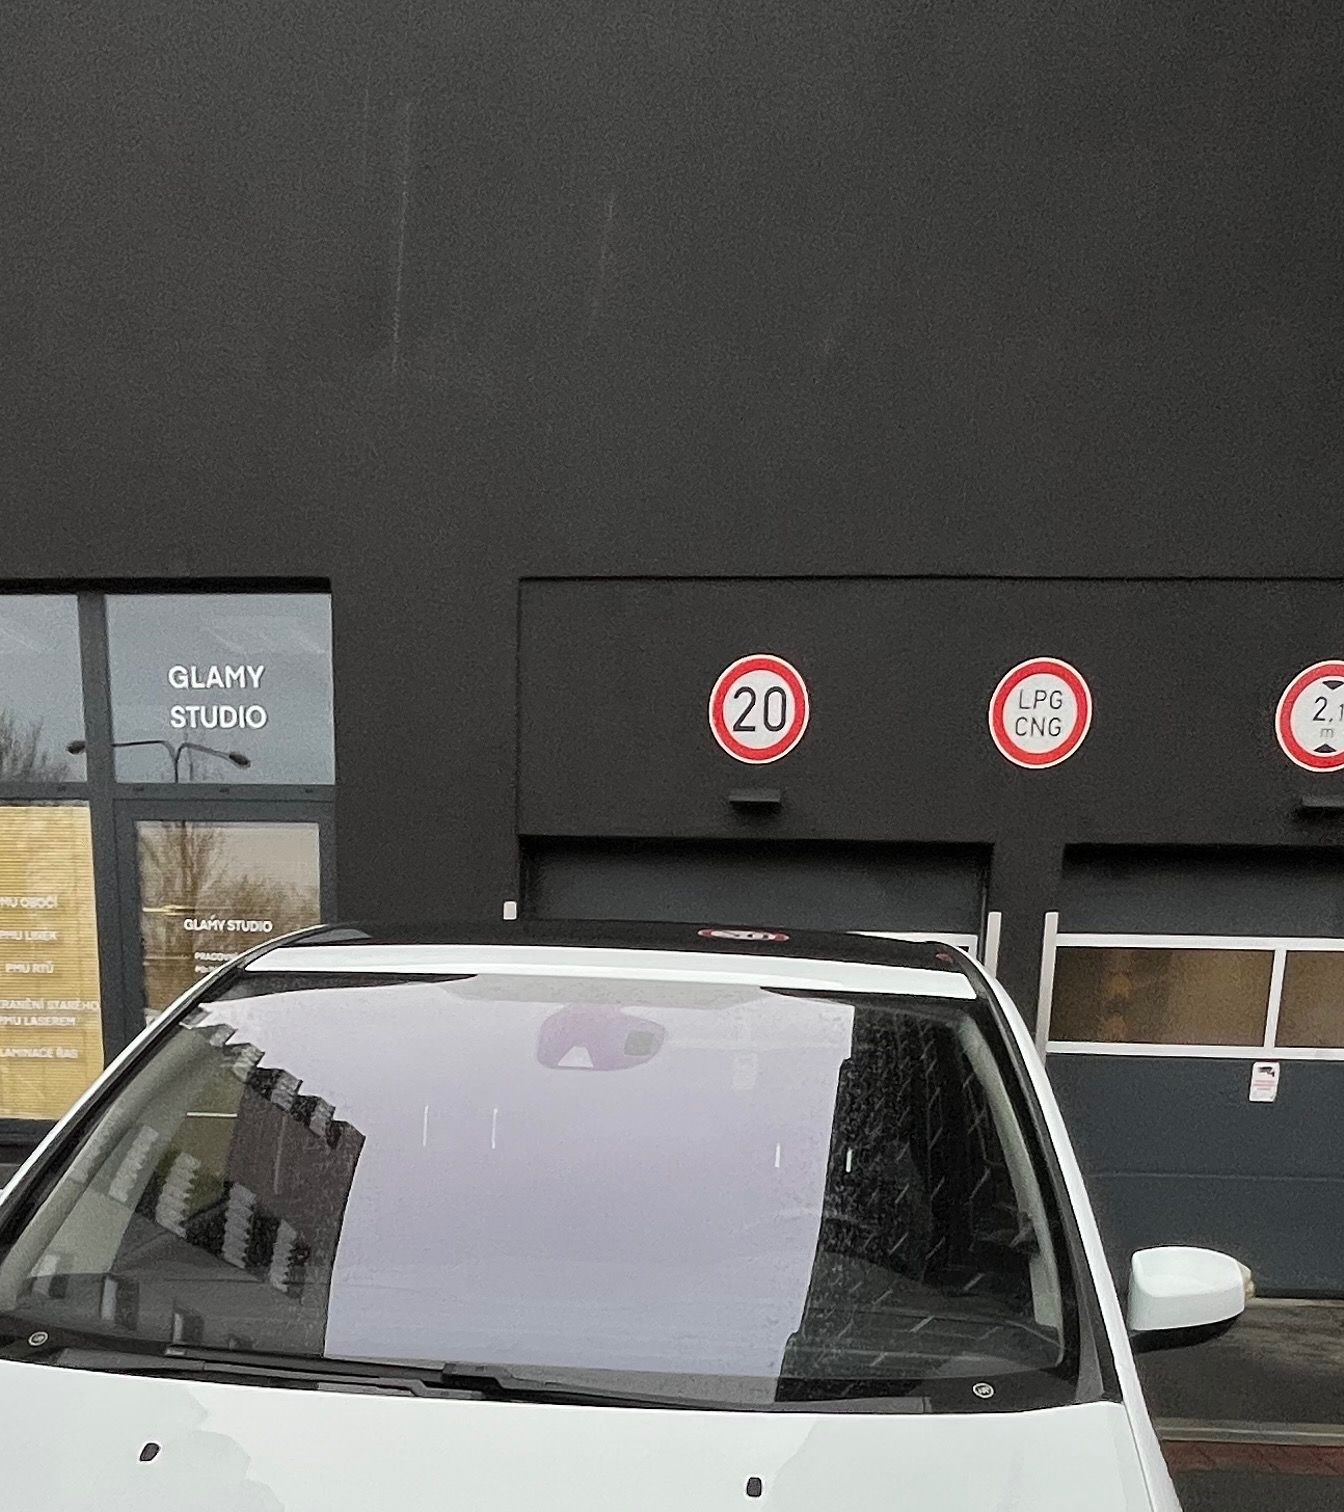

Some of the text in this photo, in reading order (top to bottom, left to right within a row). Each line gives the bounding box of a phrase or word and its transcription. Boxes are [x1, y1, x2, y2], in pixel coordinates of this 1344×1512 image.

[168, 665, 264, 689] GLAMY
[733, 686, 787, 732] 20
[1019, 689, 1063, 710] LPG
[170, 705, 267, 728] STUDIO
[1015, 716, 1061, 737] CNG
[1320, 728, 1334, 738] m
[183, 918, 274, 933] GLAMY STUDIO
